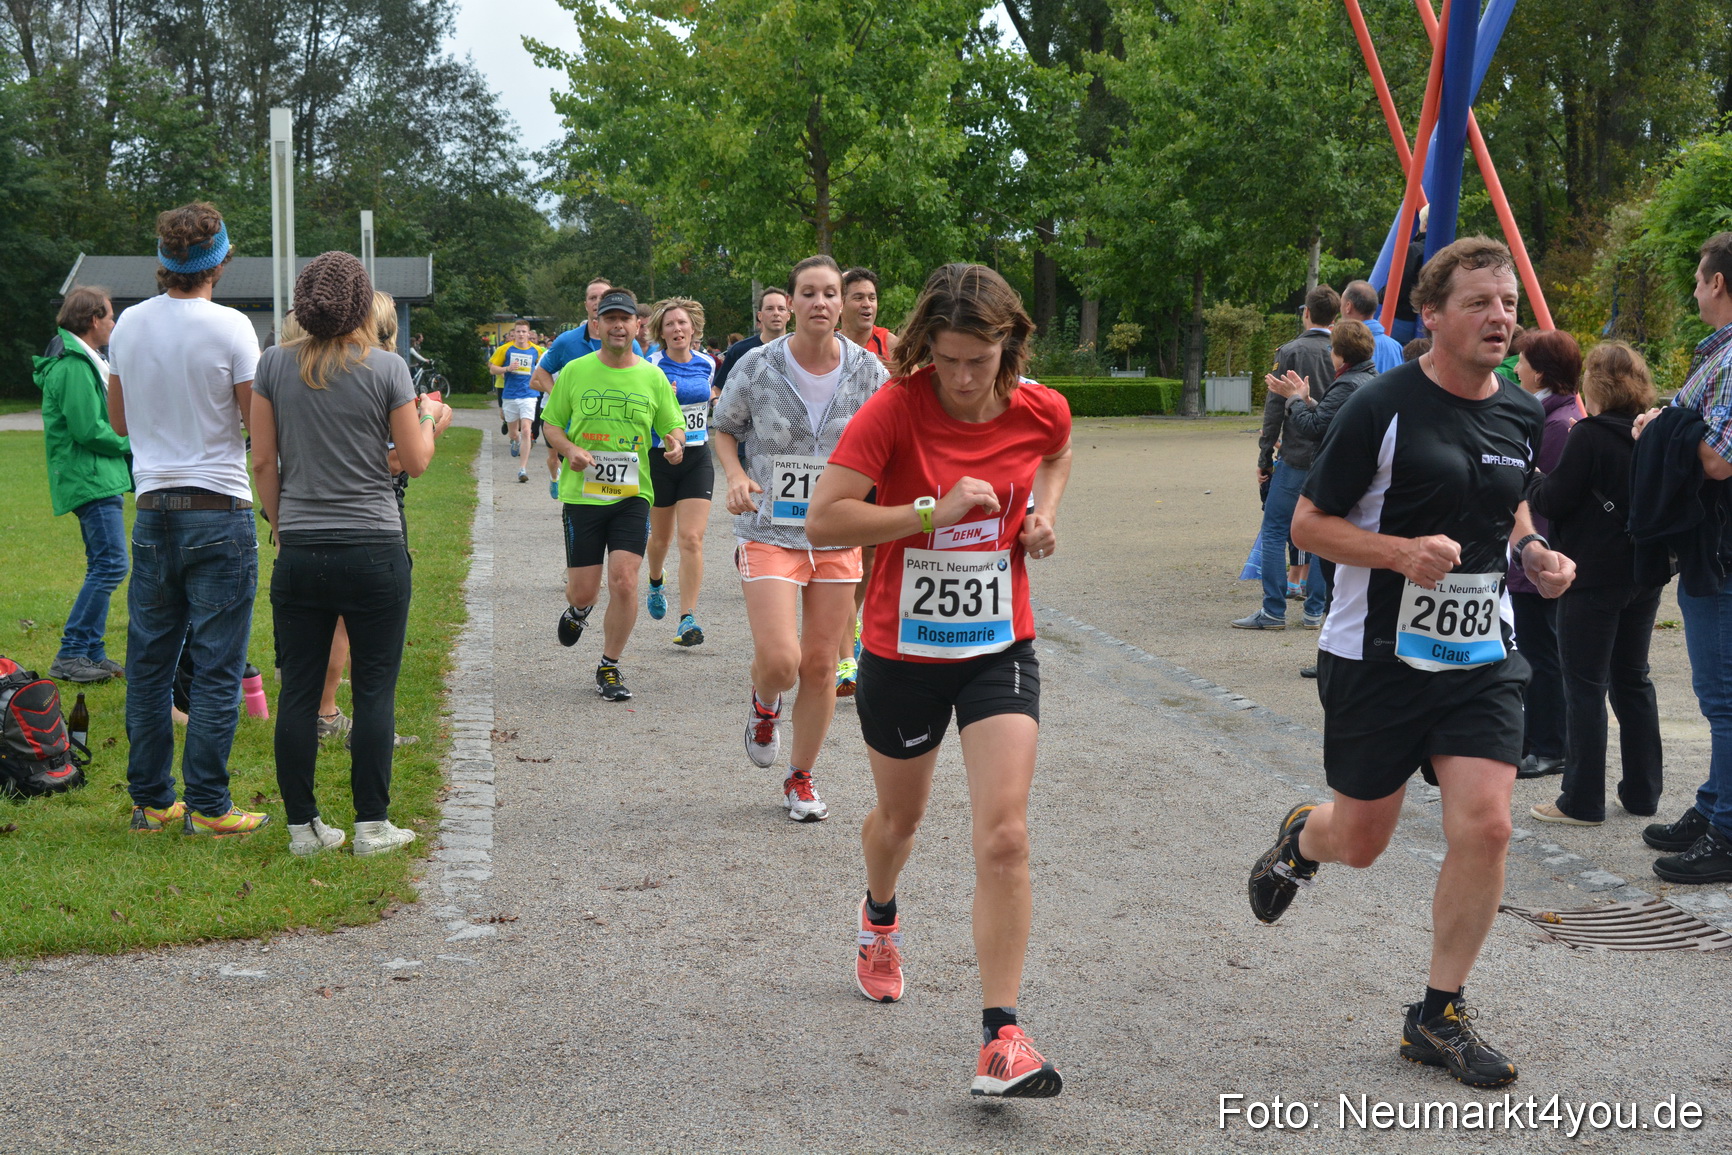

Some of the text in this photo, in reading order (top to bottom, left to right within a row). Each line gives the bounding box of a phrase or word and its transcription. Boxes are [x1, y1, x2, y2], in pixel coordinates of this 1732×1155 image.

[581, 389, 649, 419] OPF
[683, 412, 704, 430] 36
[582, 432, 611, 442] MERZ
[595, 463, 628, 483] 297
[775, 461, 826, 471] PARTL Neum
[601, 485, 622, 495] Klaus
[781, 472, 821, 499] 21
[152, 496, 191, 509] PMA
[792, 505, 807, 516] Da
[952, 527, 983, 542] DEHN
[906, 558, 994, 573] PARTL Neumarkt
[912, 576, 999, 618] 2531
[1449, 584, 1490, 594] Neumarkt
[1410, 595, 1494, 637] 2683
[917, 625, 995, 643] Rosemarie
[1432, 643, 1470, 662] Claus
